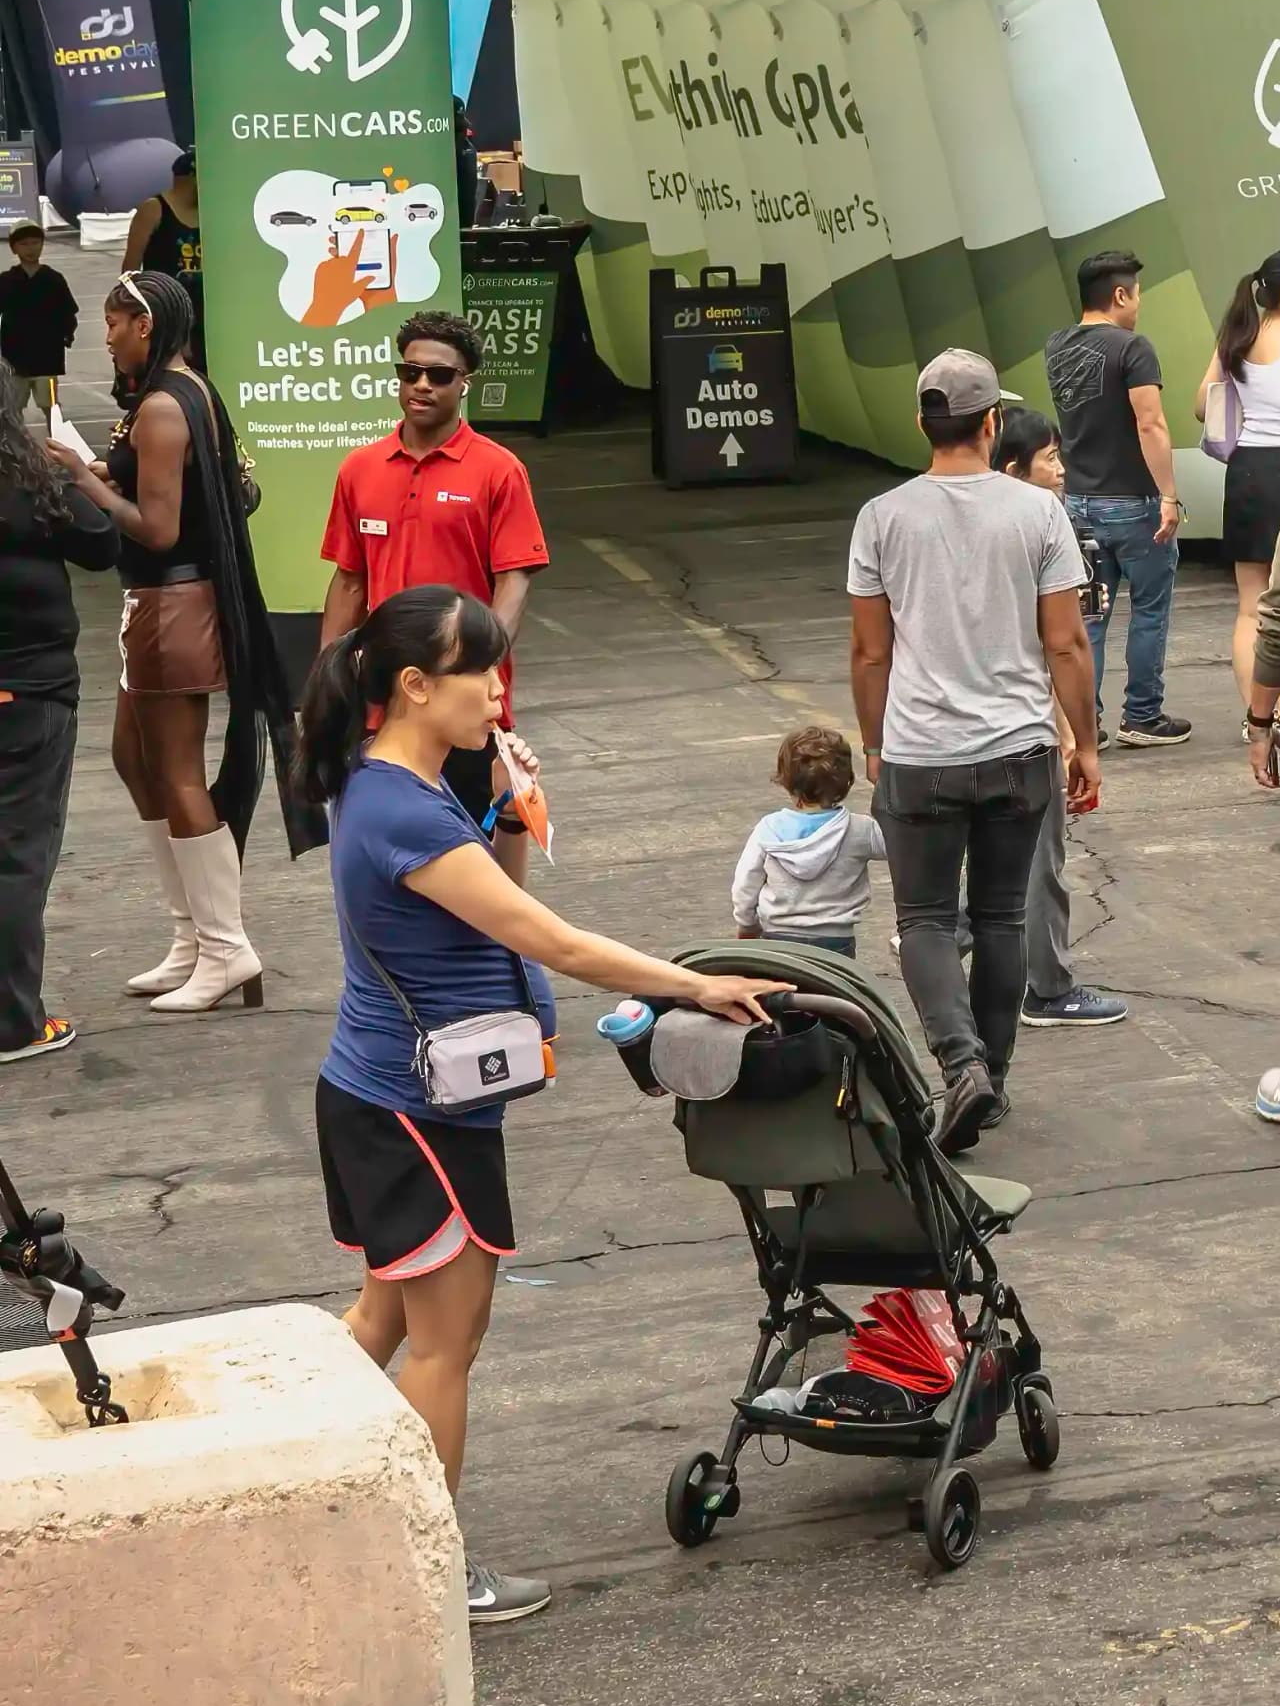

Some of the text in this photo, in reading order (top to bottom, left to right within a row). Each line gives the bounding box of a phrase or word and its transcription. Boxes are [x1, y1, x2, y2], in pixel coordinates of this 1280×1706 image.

[67, 58, 157, 78] FESTIVAL
[231, 107, 450, 140] GREENCARS.COM
[0, 173, 14, 183] uto
[466, 308, 542, 331] DASH
[256, 335, 392, 368] Let's find
[481, 332, 540, 355] ASS
[238, 374, 344, 409] perfect
[697, 379, 759, 402] Auto
[247, 421, 294, 434] Discover
[295, 421, 316, 434] the
[318, 421, 348, 434] ideal
[685, 407, 775, 430] Demos
[256, 438, 303, 450] matches
[304, 438, 334, 451] your
